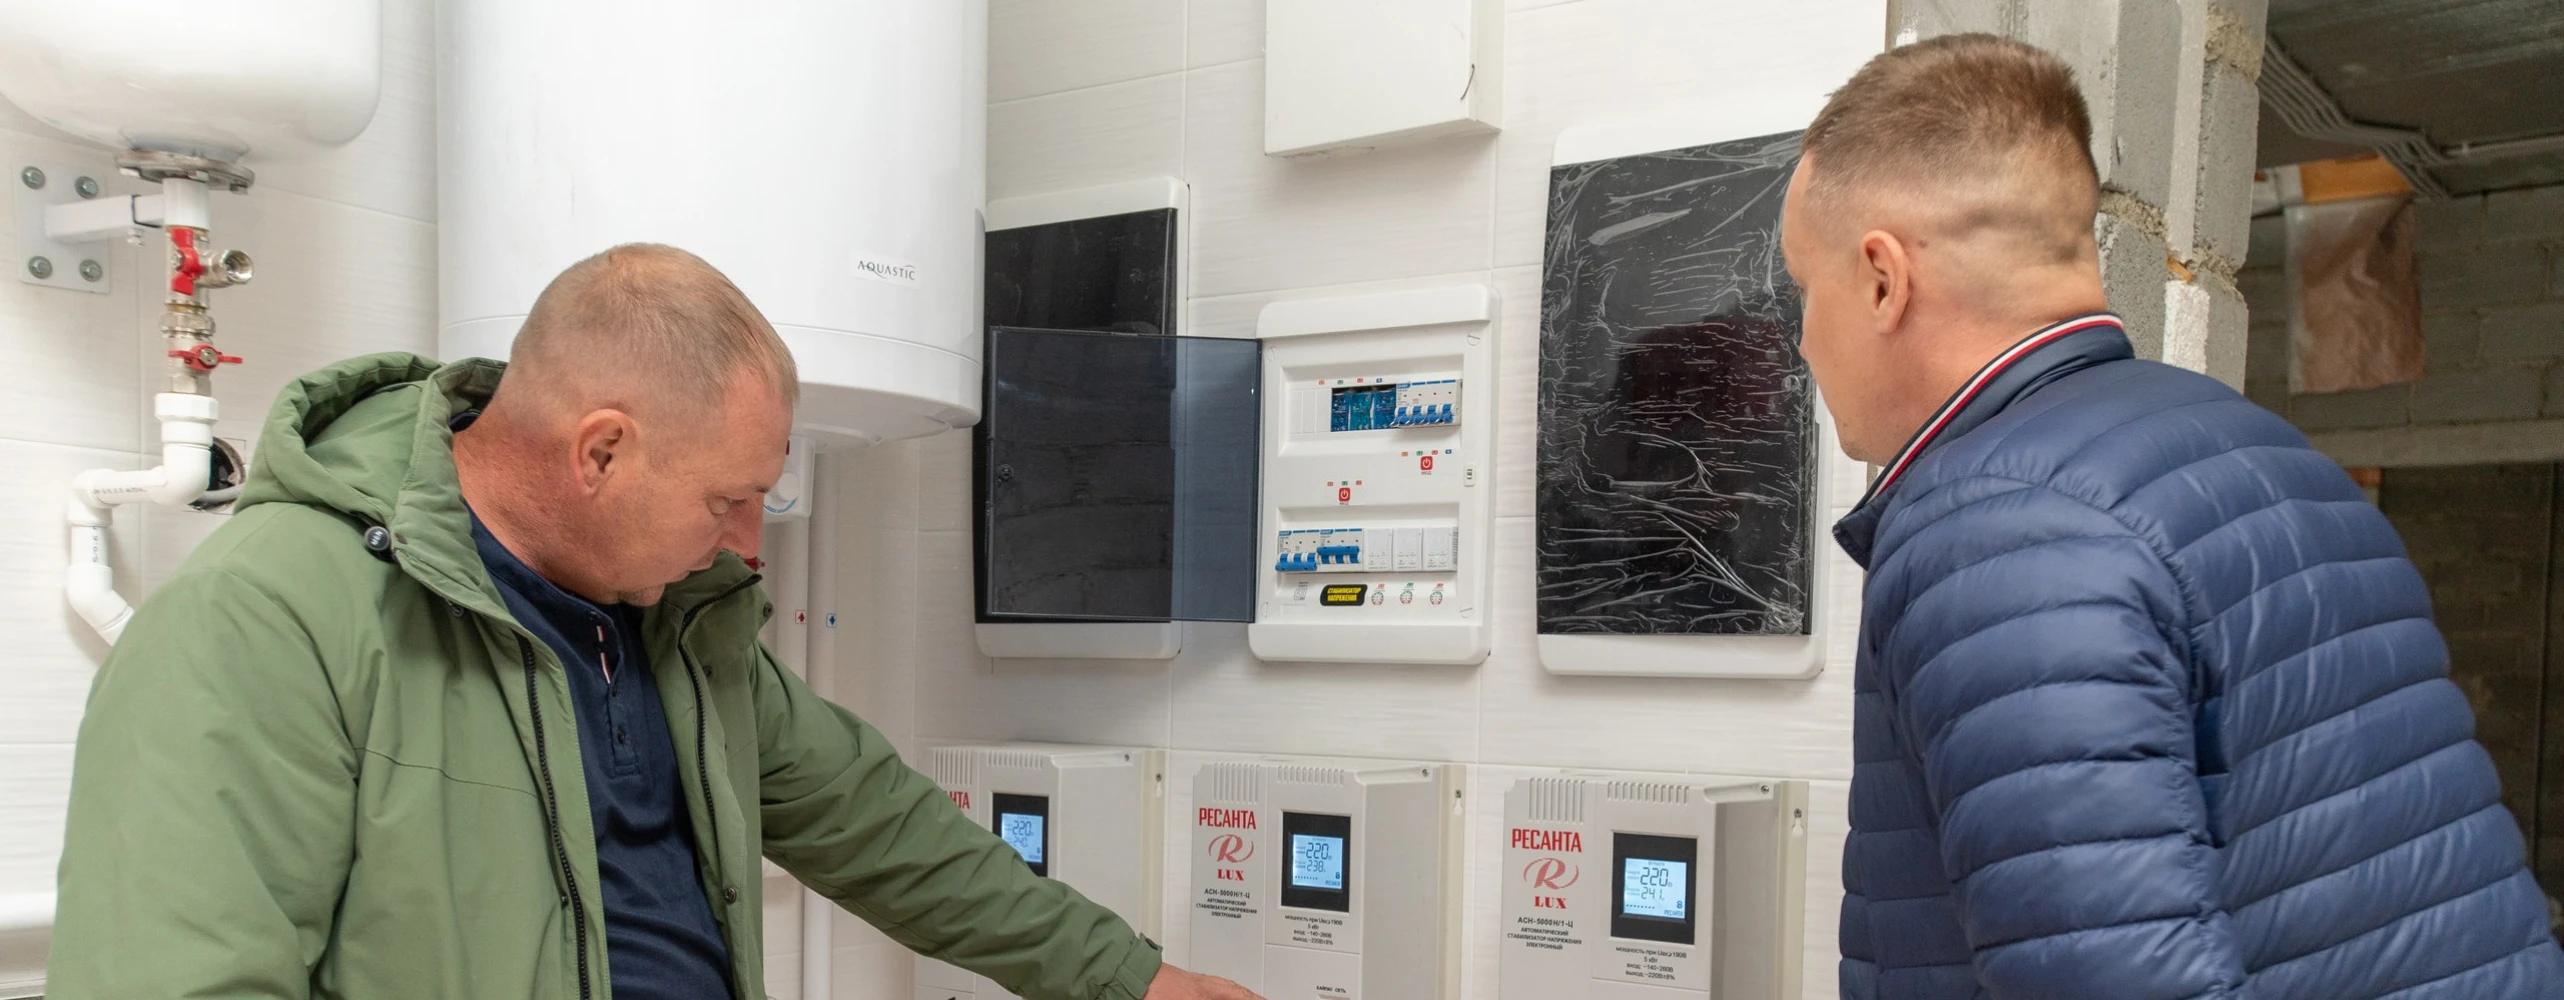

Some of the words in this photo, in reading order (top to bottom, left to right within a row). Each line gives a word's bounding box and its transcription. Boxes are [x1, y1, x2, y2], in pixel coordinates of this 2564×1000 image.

[858, 260, 915, 280] AQUASTIC
[1198, 807, 1257, 830] РЕСАНТА
[1511, 828, 1582, 853] РЕСАНТА
[1217, 868, 1244, 881] LUX
[1534, 896, 1567, 909] LUX
